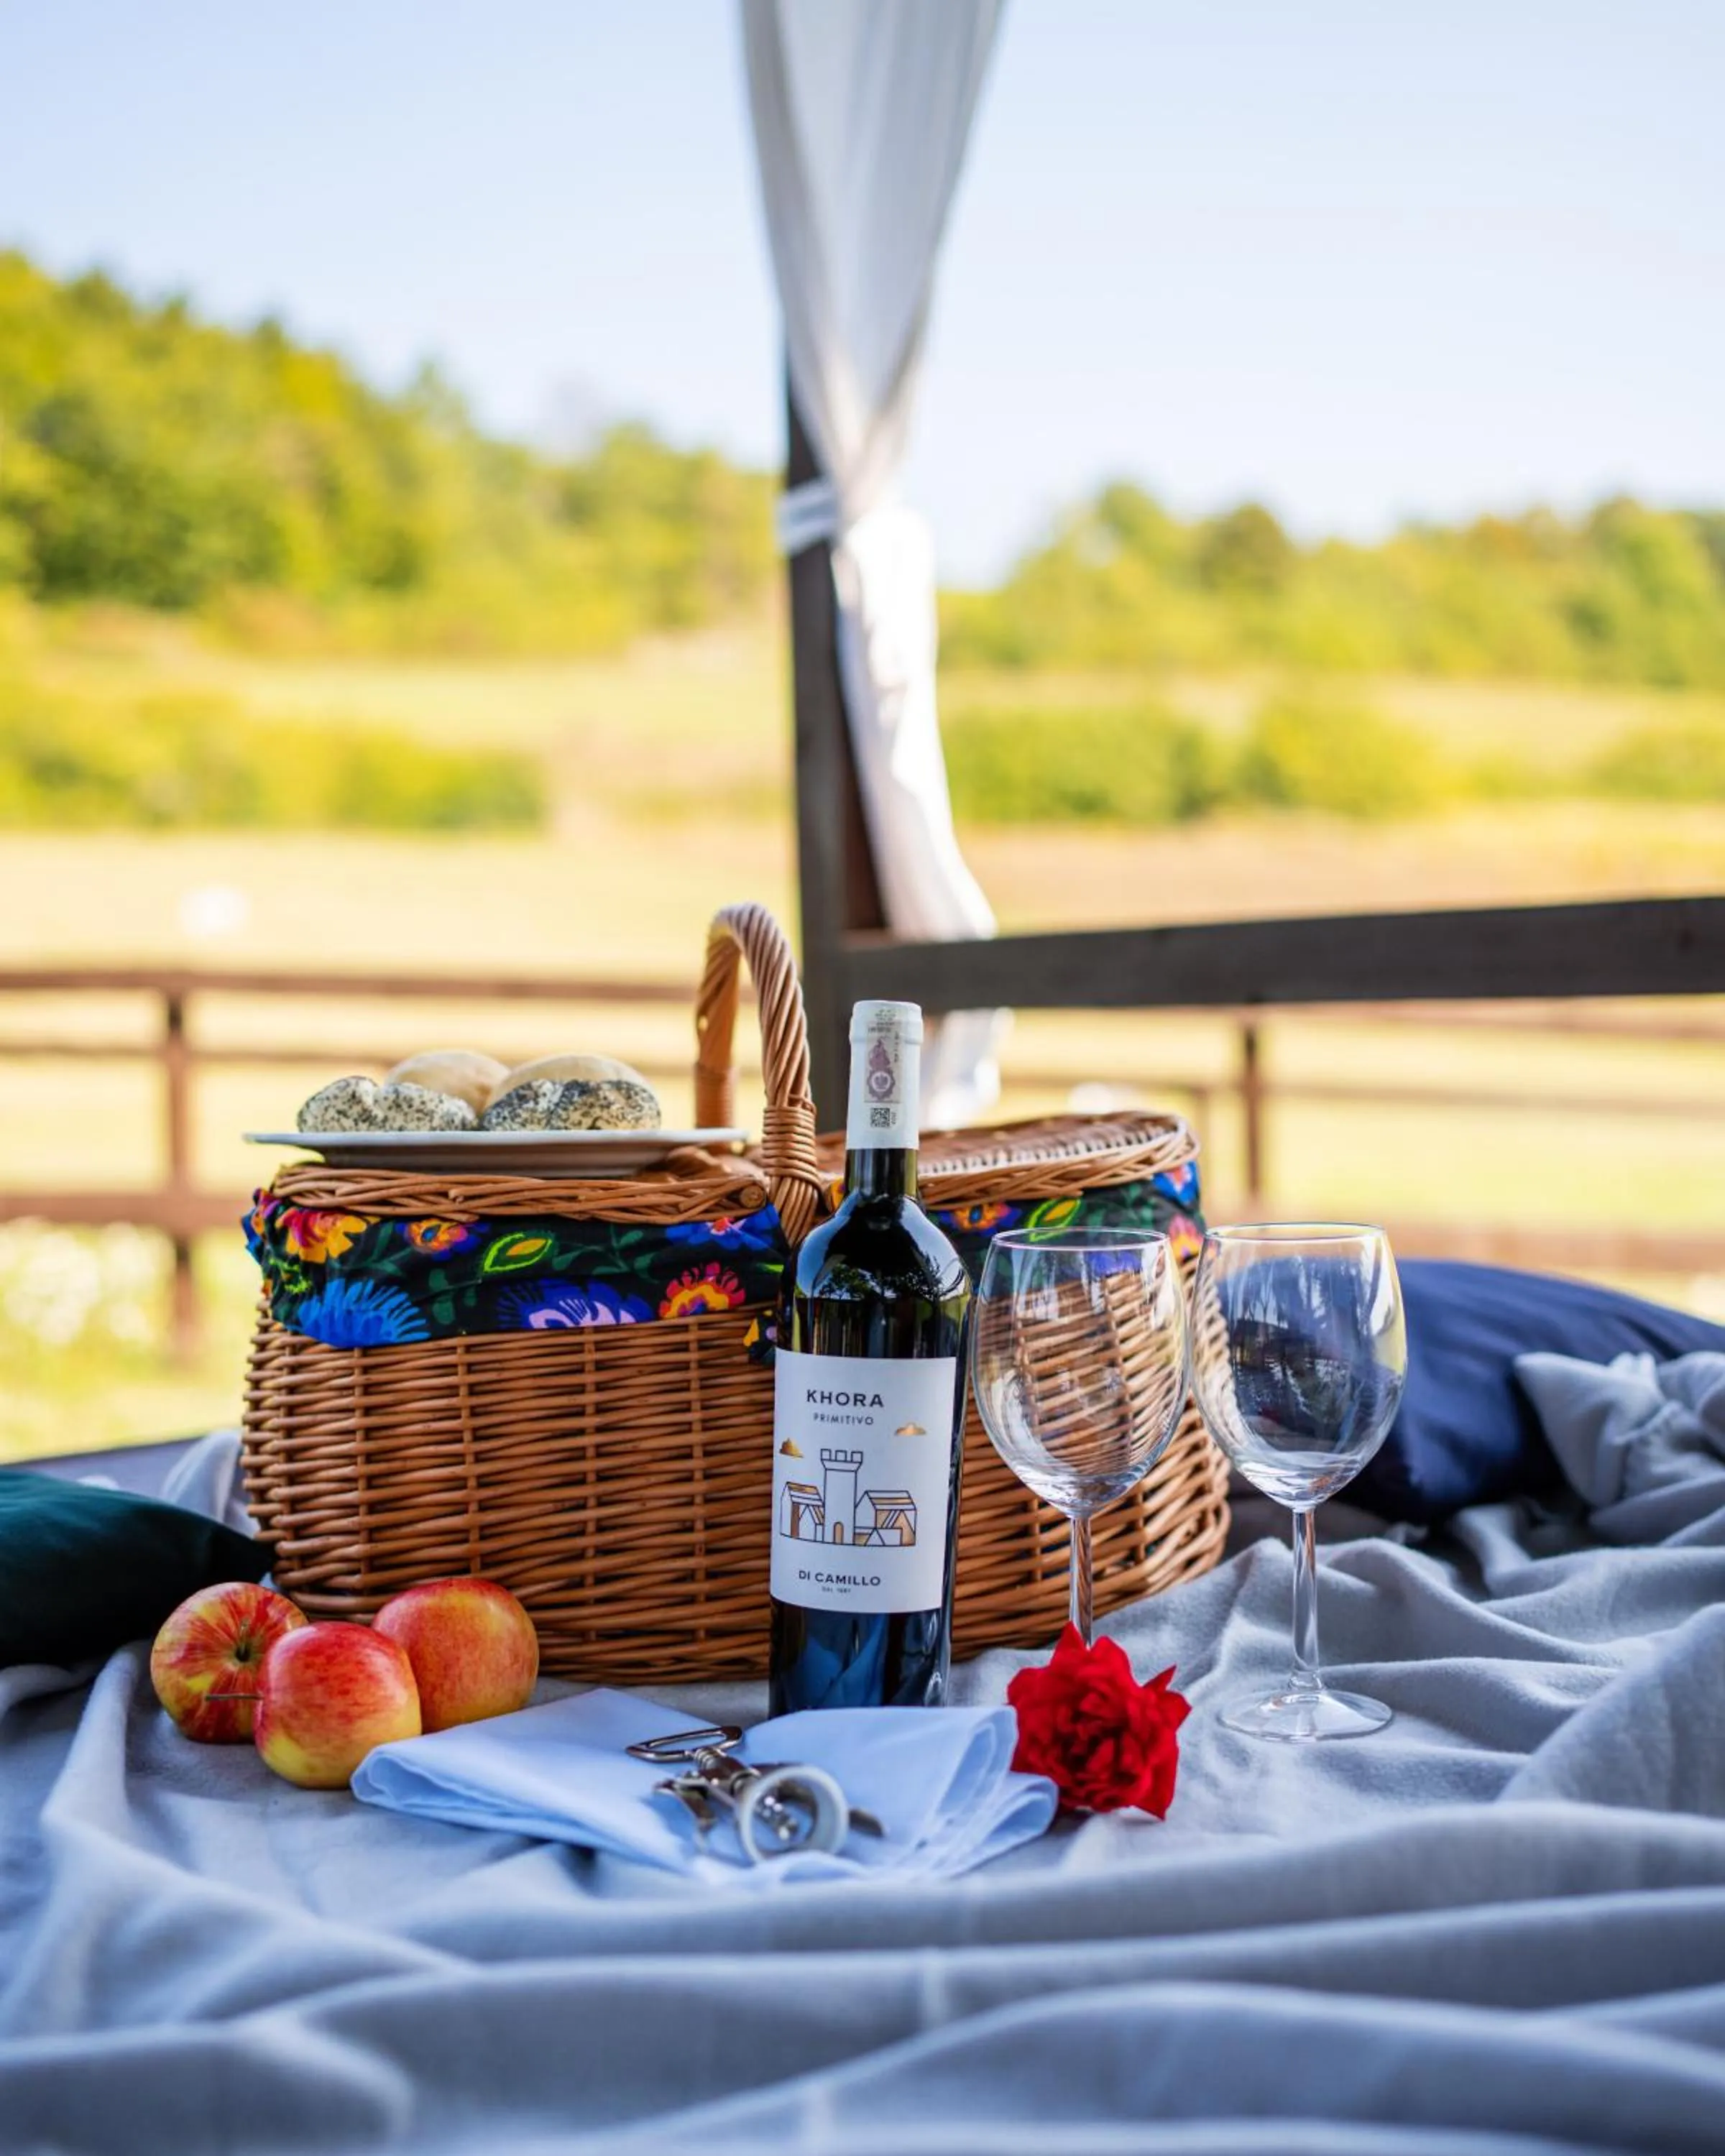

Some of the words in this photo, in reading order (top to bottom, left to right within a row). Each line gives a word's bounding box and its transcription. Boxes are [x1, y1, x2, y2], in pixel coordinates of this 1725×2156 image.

[806, 1389, 884, 1407] KHORA
[813, 1413, 874, 1425] PRIMITIVO
[799, 1570, 810, 1580] DI
[815, 1572, 880, 1586] CAMILLO
